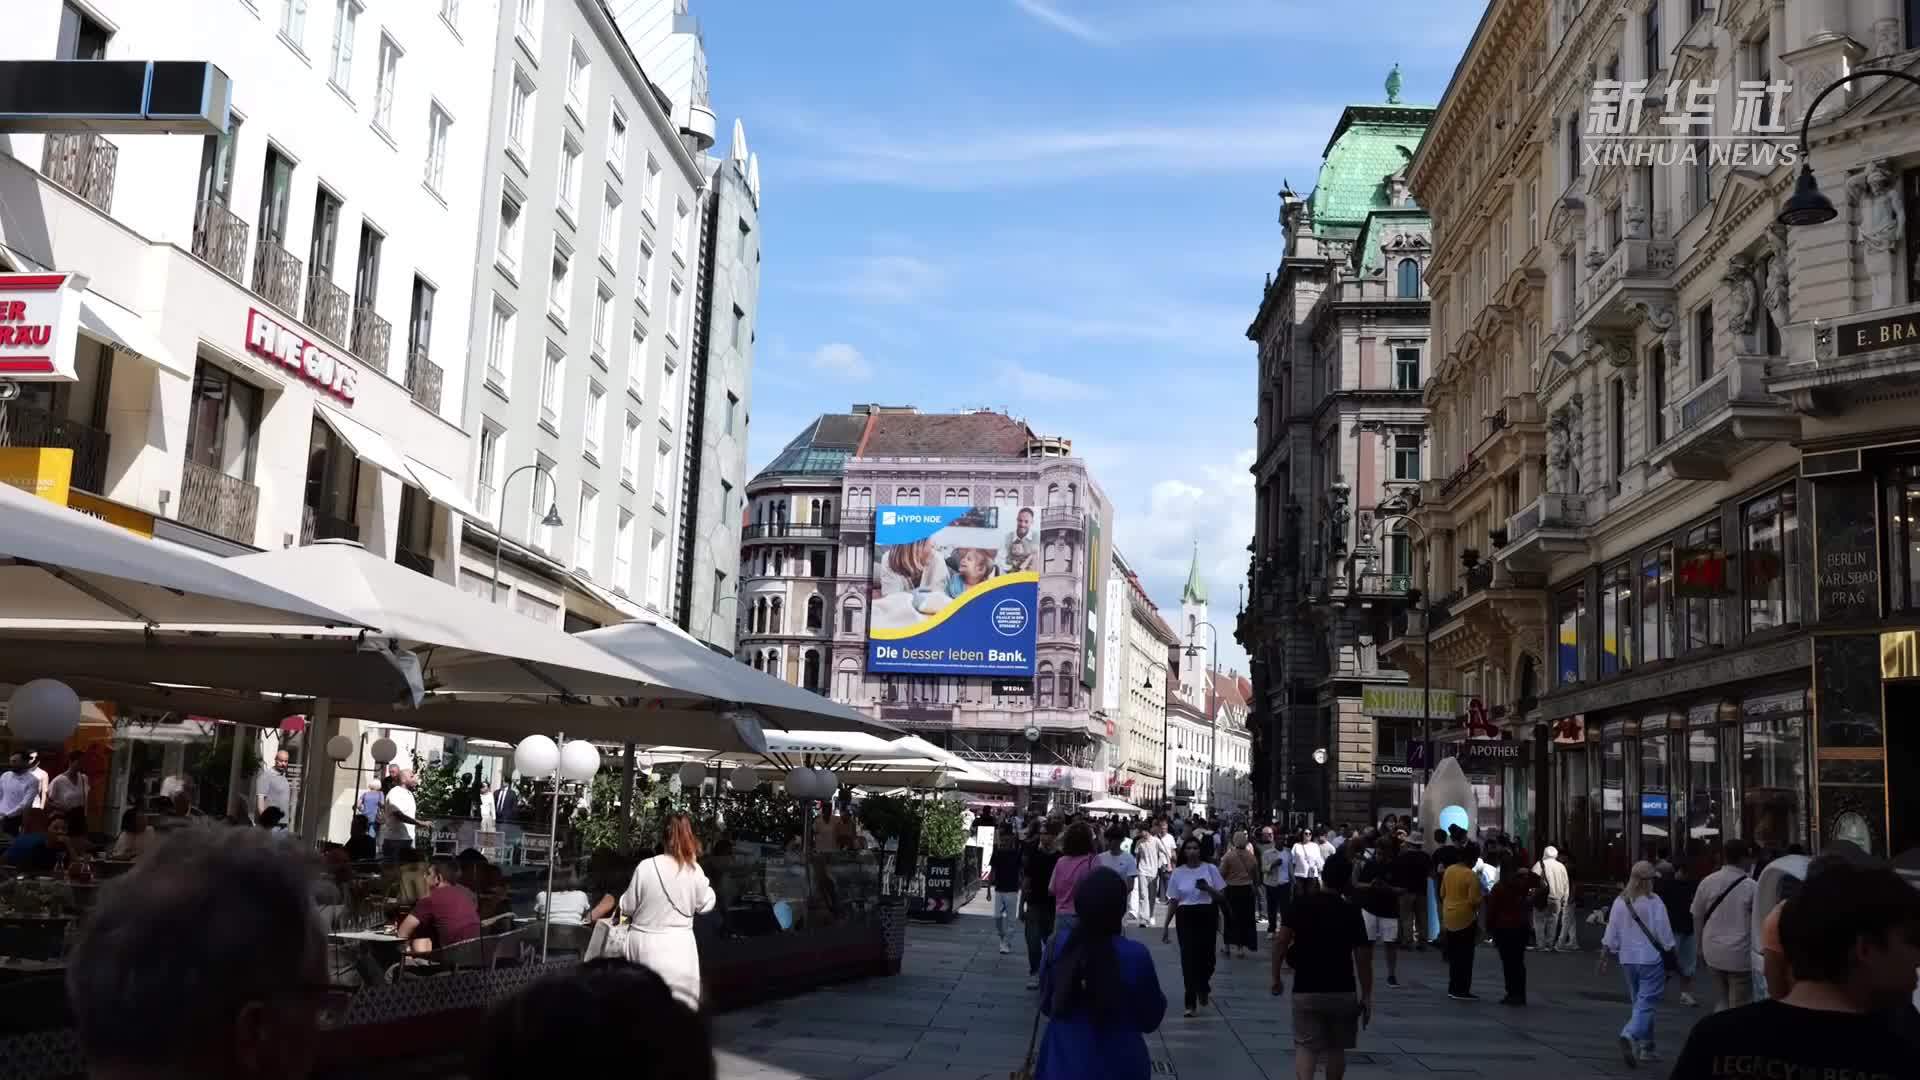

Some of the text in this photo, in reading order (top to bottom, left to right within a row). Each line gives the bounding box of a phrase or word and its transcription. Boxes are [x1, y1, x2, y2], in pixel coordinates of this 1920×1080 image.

[1856, 320, 1918, 347] E. BRA
[303, 345, 358, 399] GUYS
[897, 514, 942, 524] HYPO NOE
[1827, 551, 1866, 568] BERLIN
[1832, 589, 1865, 606] PRAG
[876, 646, 1027, 663] Die besser leben Bank.
[1470, 745, 1520, 758] APOTHEKE
[930, 866, 950, 876] FIVE
[928, 879, 951, 888] GUYS
